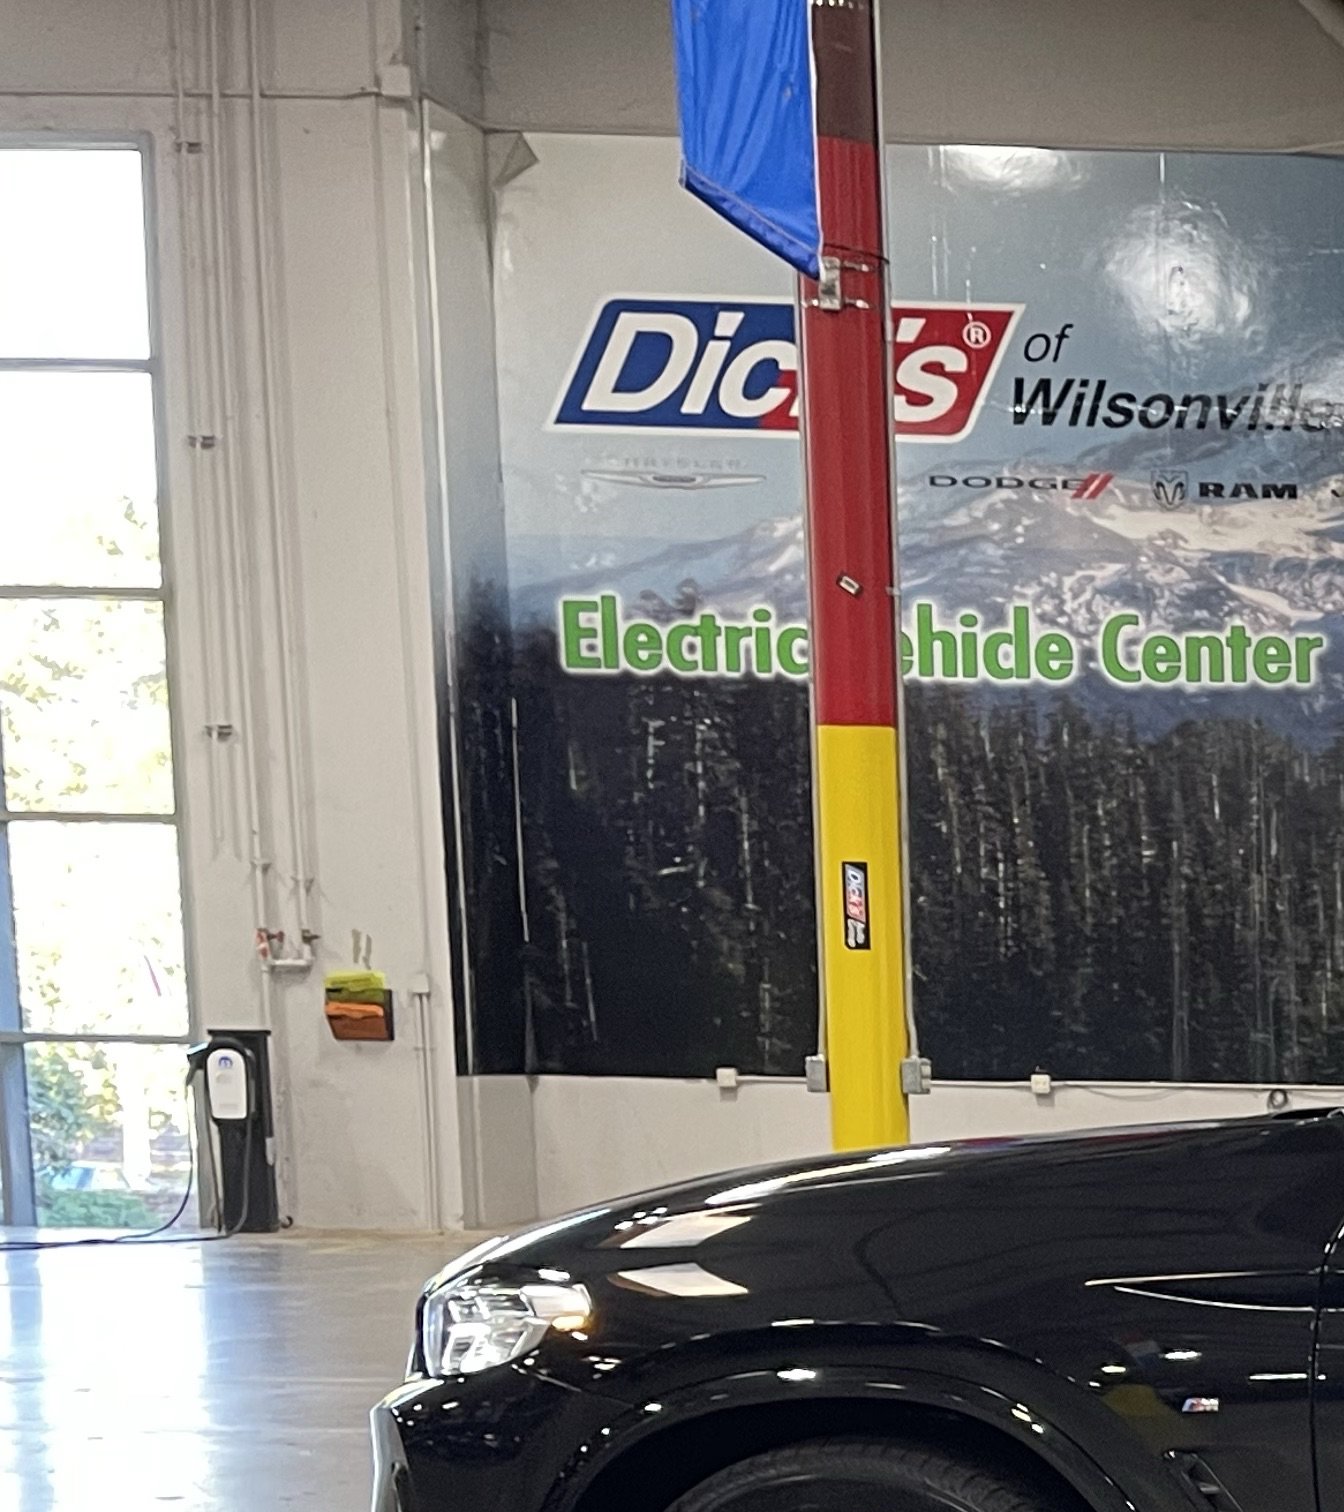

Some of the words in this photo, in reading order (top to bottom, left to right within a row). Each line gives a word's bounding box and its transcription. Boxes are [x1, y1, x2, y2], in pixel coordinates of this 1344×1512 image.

[1023, 323, 1074, 363] of
[928, 474, 1089, 492] DODGE
[1198, 481, 1299, 500] RAM
[562, 594, 809, 675] Electric
[900, 603, 1074, 680] hicle
[1101, 613, 1324, 684] Center
